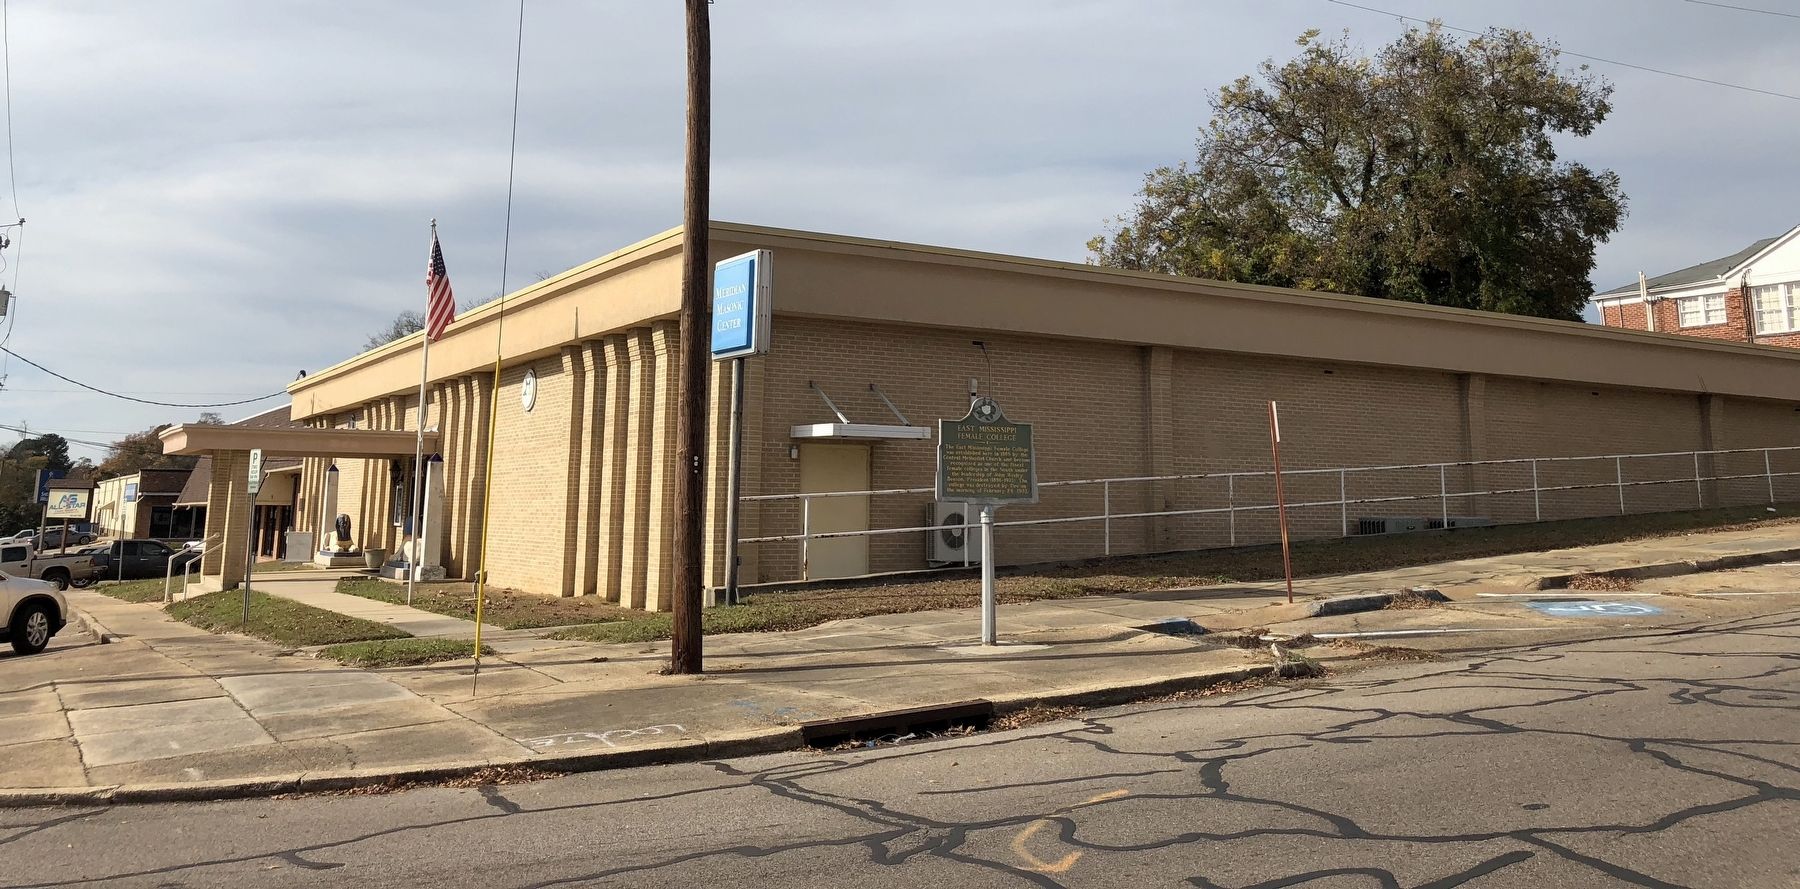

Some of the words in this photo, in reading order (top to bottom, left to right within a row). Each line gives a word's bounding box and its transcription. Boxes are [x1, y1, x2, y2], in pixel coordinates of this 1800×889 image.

[715, 281, 747, 299] MERIDIAN
[716, 300, 744, 314] MASONIC
[717, 318, 742, 332] CENTER
[979, 425, 1017, 434] MISSISSIPPI
[986, 434, 1017, 442] COLLEGE
[253, 452, 258, 464] P
